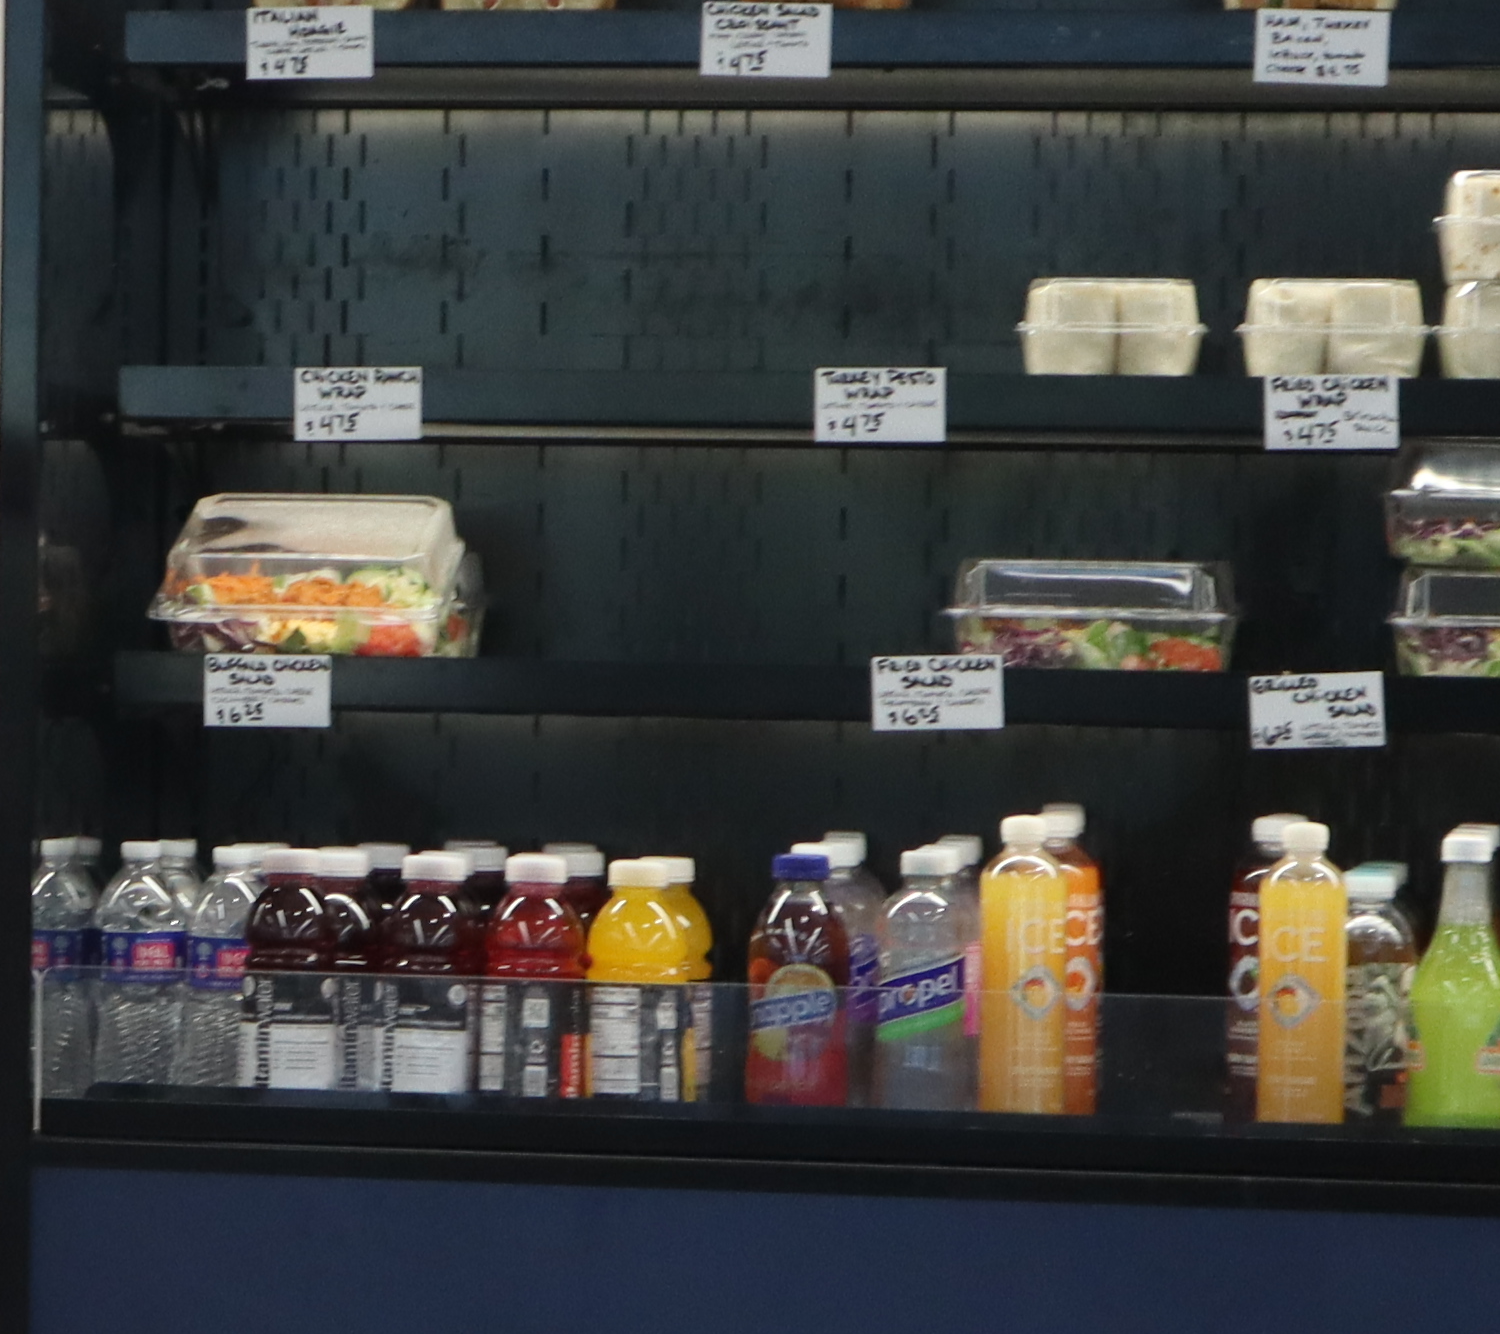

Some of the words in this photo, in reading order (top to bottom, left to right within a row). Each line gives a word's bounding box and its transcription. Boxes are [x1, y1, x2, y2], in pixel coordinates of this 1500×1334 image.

[318, 386, 367, 399] WRAP
[844, 386, 895, 399] WRAP
[1065, 908, 1104, 946] CE
[1228, 908, 1260, 947] IC
